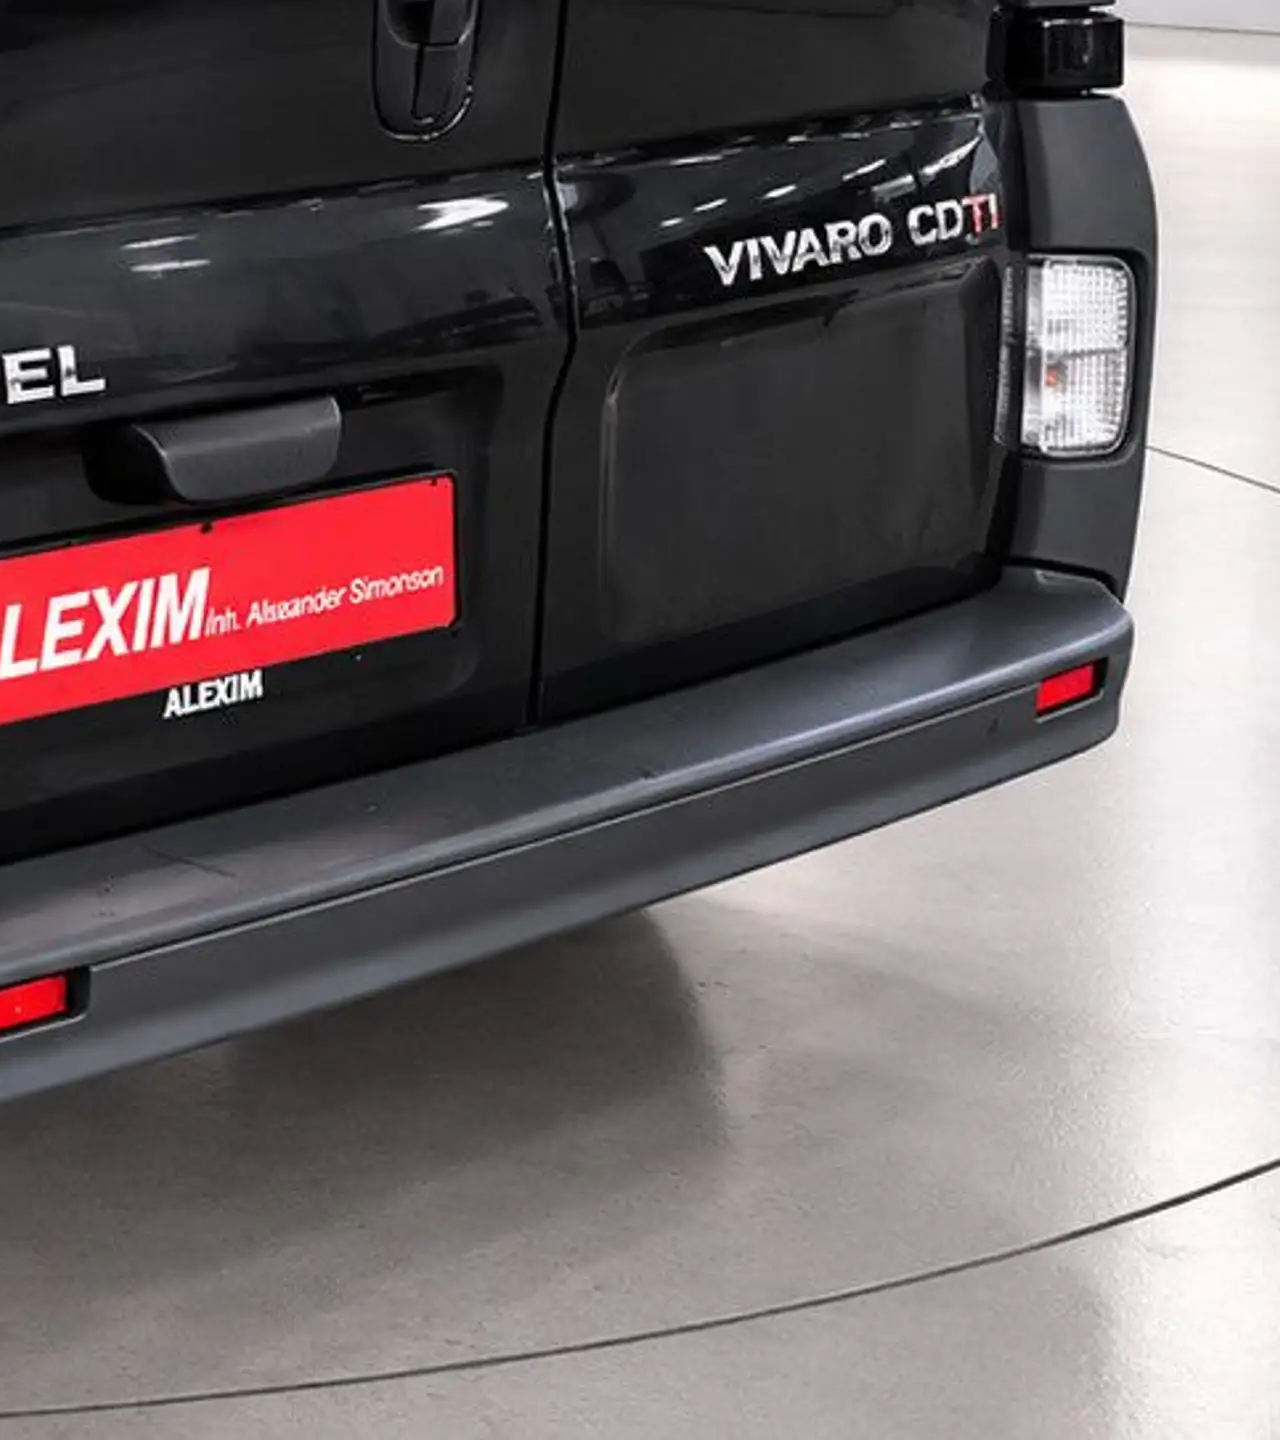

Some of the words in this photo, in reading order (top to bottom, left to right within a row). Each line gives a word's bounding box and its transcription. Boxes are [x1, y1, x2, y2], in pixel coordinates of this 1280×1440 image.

[705, 213, 892, 286] VIVARO
[907, 193, 999, 246] CDTI
[349, 564, 444, 604] Simonson
[163, 670, 263, 719] ALEXIM
